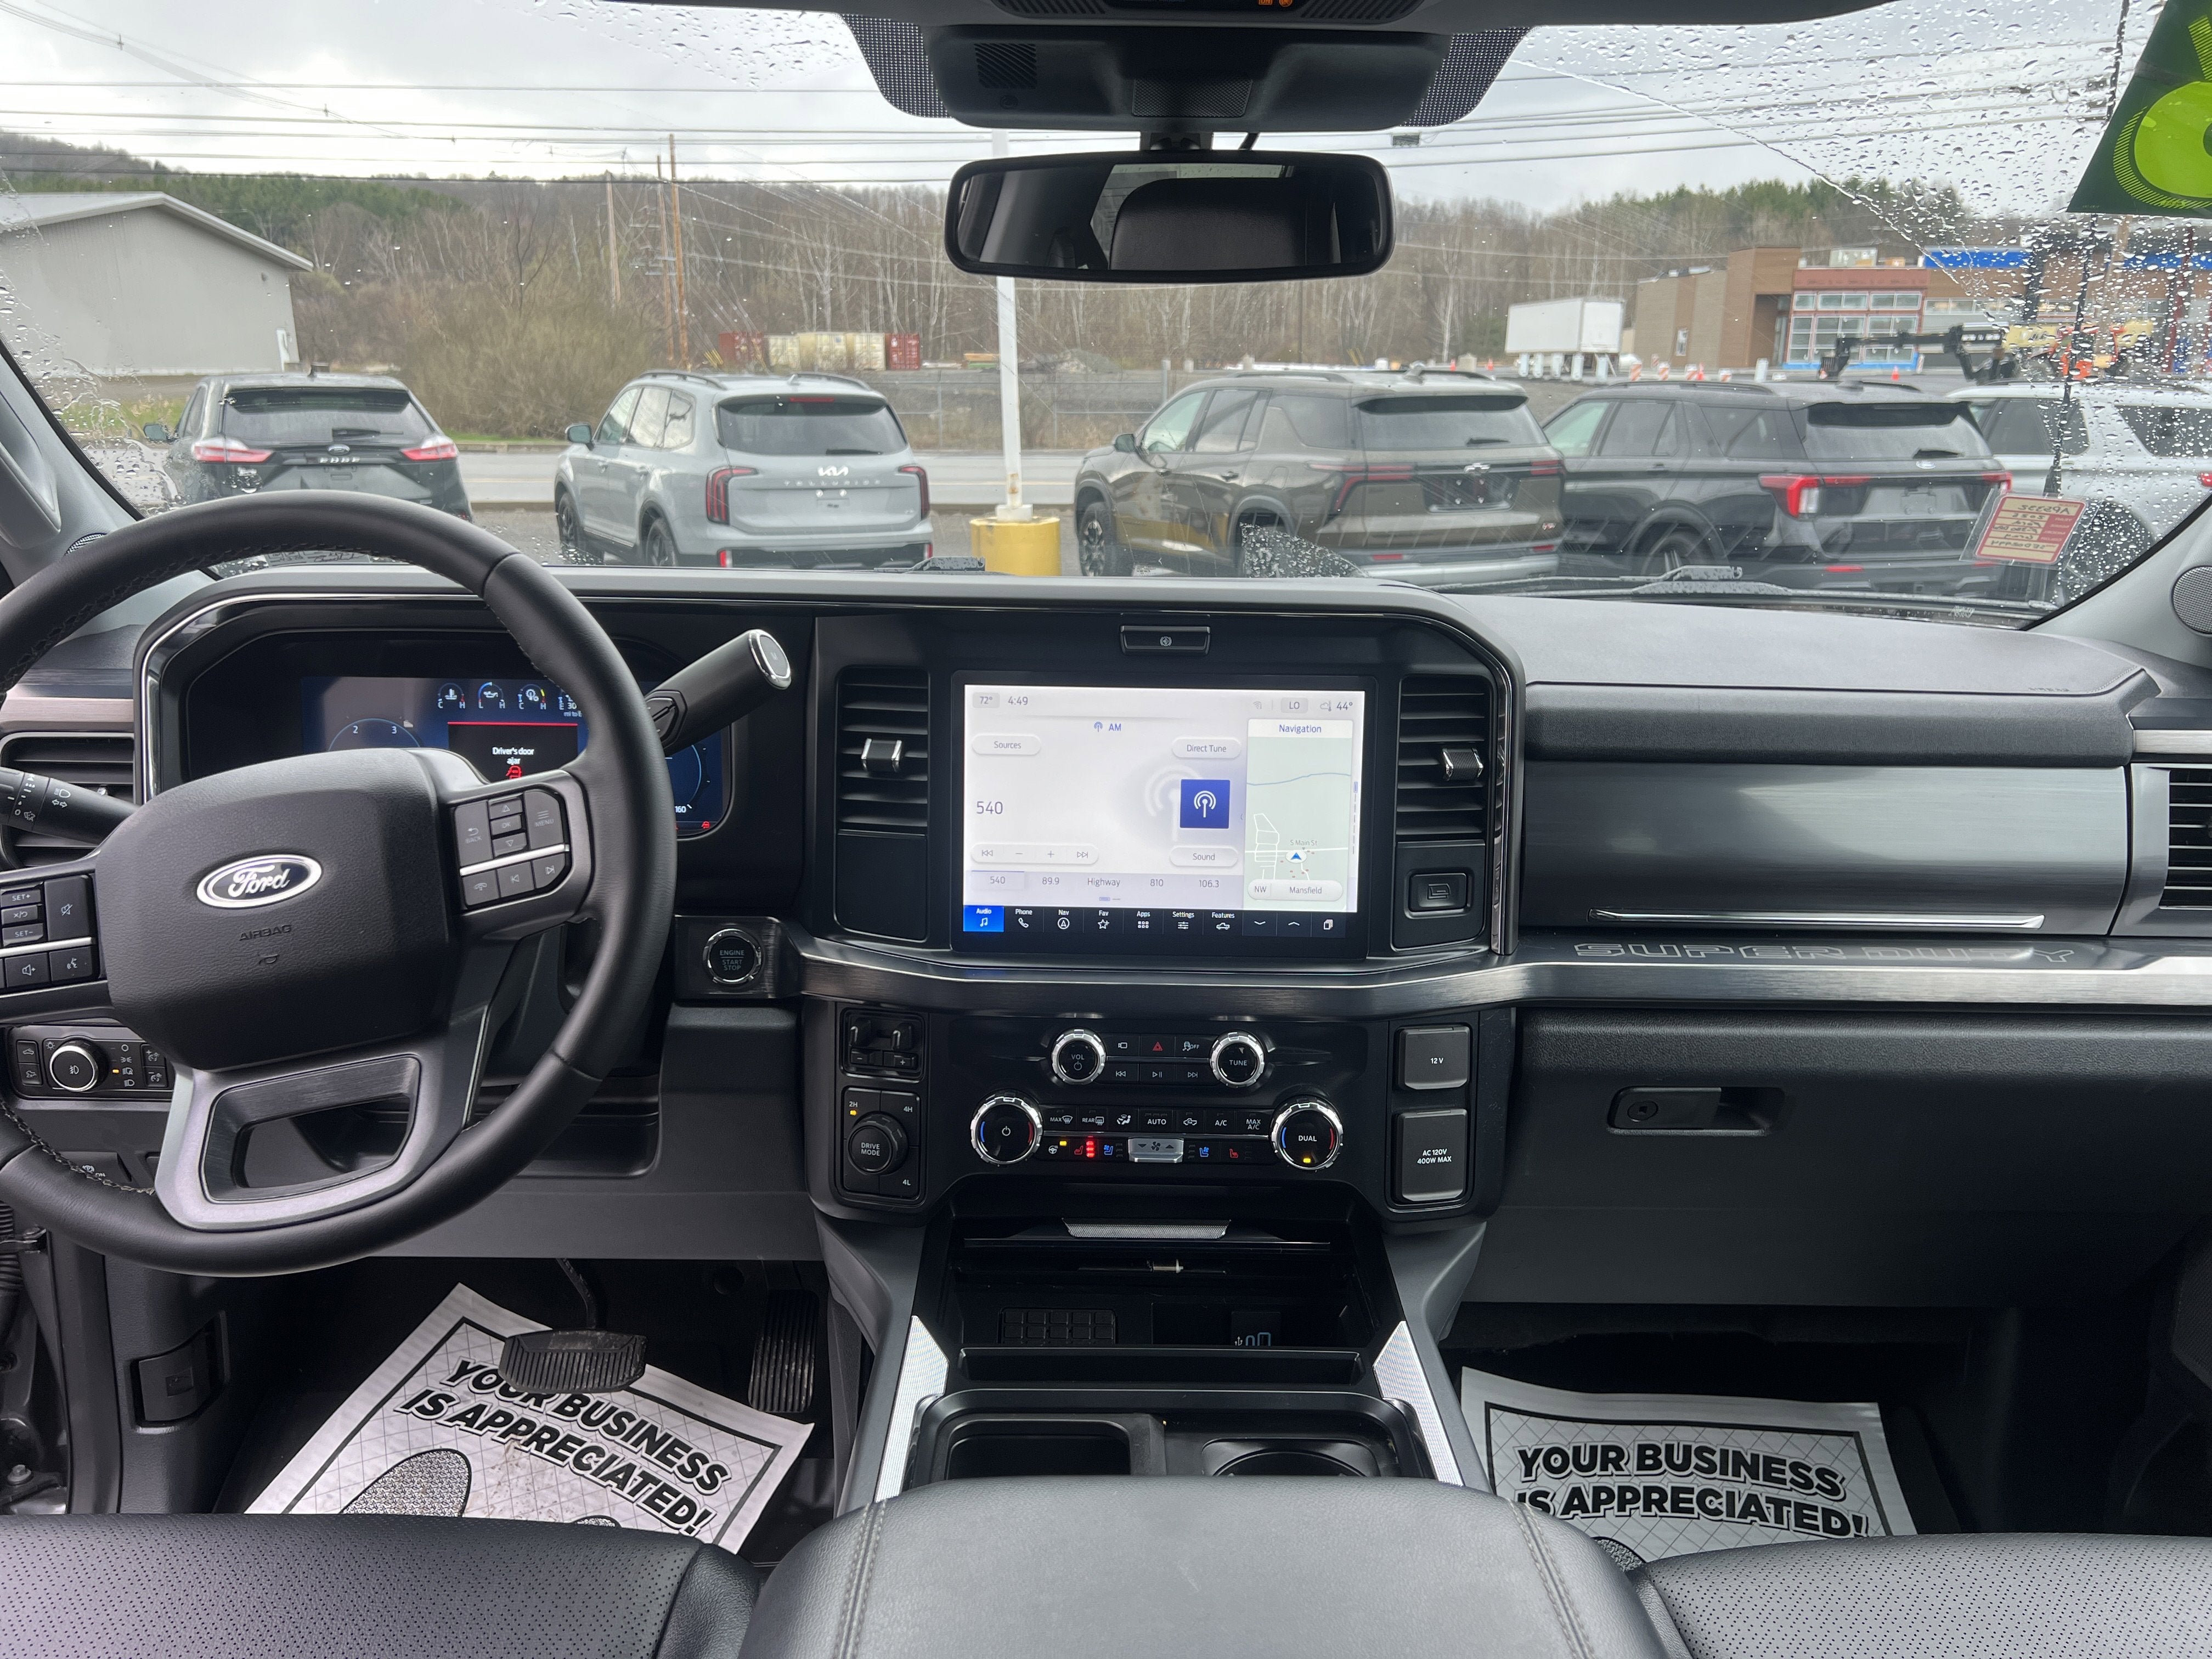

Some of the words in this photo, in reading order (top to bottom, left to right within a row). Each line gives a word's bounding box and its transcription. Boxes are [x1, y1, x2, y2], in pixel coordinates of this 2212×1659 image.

[1008, 696, 1029, 706] 4:49
[1289, 702, 1300, 710] LO
[353, 725, 358, 734] 2
[392, 726, 397, 734] 3
[1109, 724, 1122, 732] AM
[1279, 724, 1322, 734] Navigation
[994, 741, 1022, 749] Sources
[492, 747, 517, 755] Driver's
[518, 747, 535, 755] door
[506, 757, 521, 765] ajar
[976, 801, 1003, 814] 540
[228, 865, 292, 898] Ford
[990, 876, 1006, 884] 540
[1042, 877, 1060, 885] 89.9
[1087, 878, 1120, 888] Highway
[1150, 879, 1164, 887] 810
[1199, 879, 1219, 888] 106.3
[239, 924, 292, 941] AIRBAG
[1573, 943, 1847, 960] SUPER
[1861, 947, 2074, 963] DUTY
[1215, 1119, 1227, 1127] A/C
[551, 1392, 729, 1492] BUSINESS
[402, 1389, 455, 1417] IS
[443, 1403, 713, 1534] APPRECIATED!
[1517, 1445, 1625, 1478] YOUR
[1637, 1443, 1845, 1498] BUSINESS
[1559, 1486, 1863, 1536] APPRECIATED!
